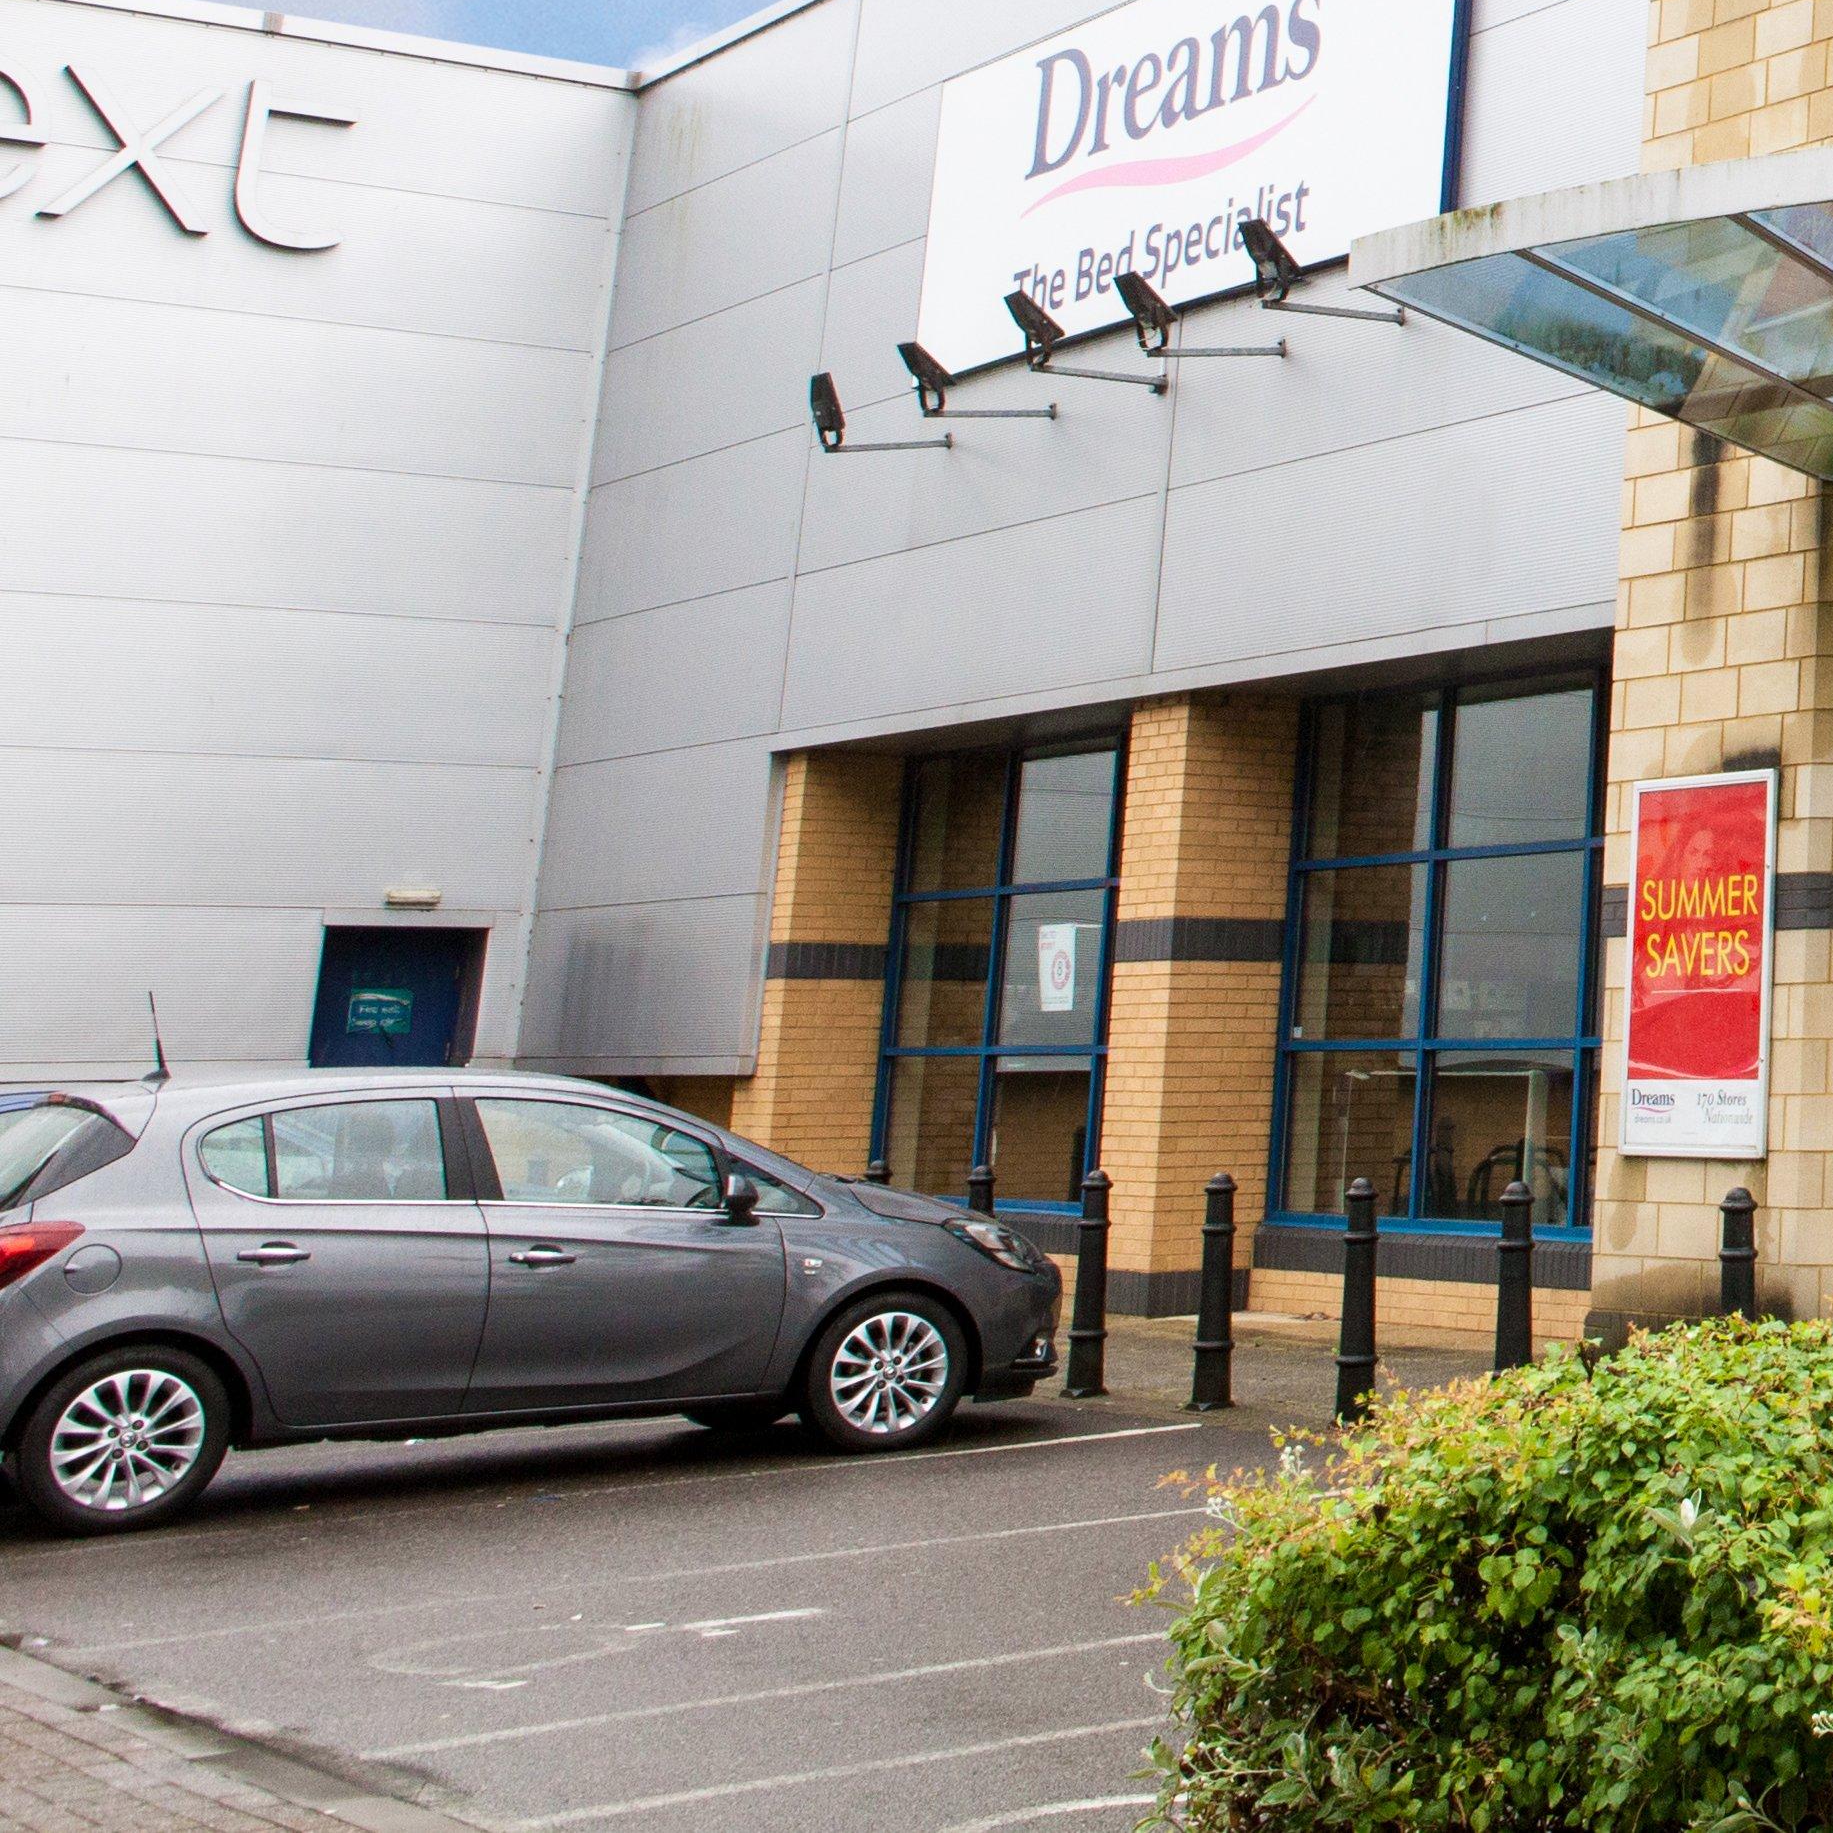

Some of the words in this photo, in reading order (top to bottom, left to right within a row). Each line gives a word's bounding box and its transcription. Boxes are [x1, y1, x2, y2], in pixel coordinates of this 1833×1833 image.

[1075, 229, 1135, 302] Bed
[1641, 874, 1758, 921] SUMMER
[1645, 929, 1750, 978] SAVERS
[1632, 1088, 1675, 1106] Dreams
[1697, 1092, 1715, 1108] 170
[1717, 1089, 1747, 1106] Stores
